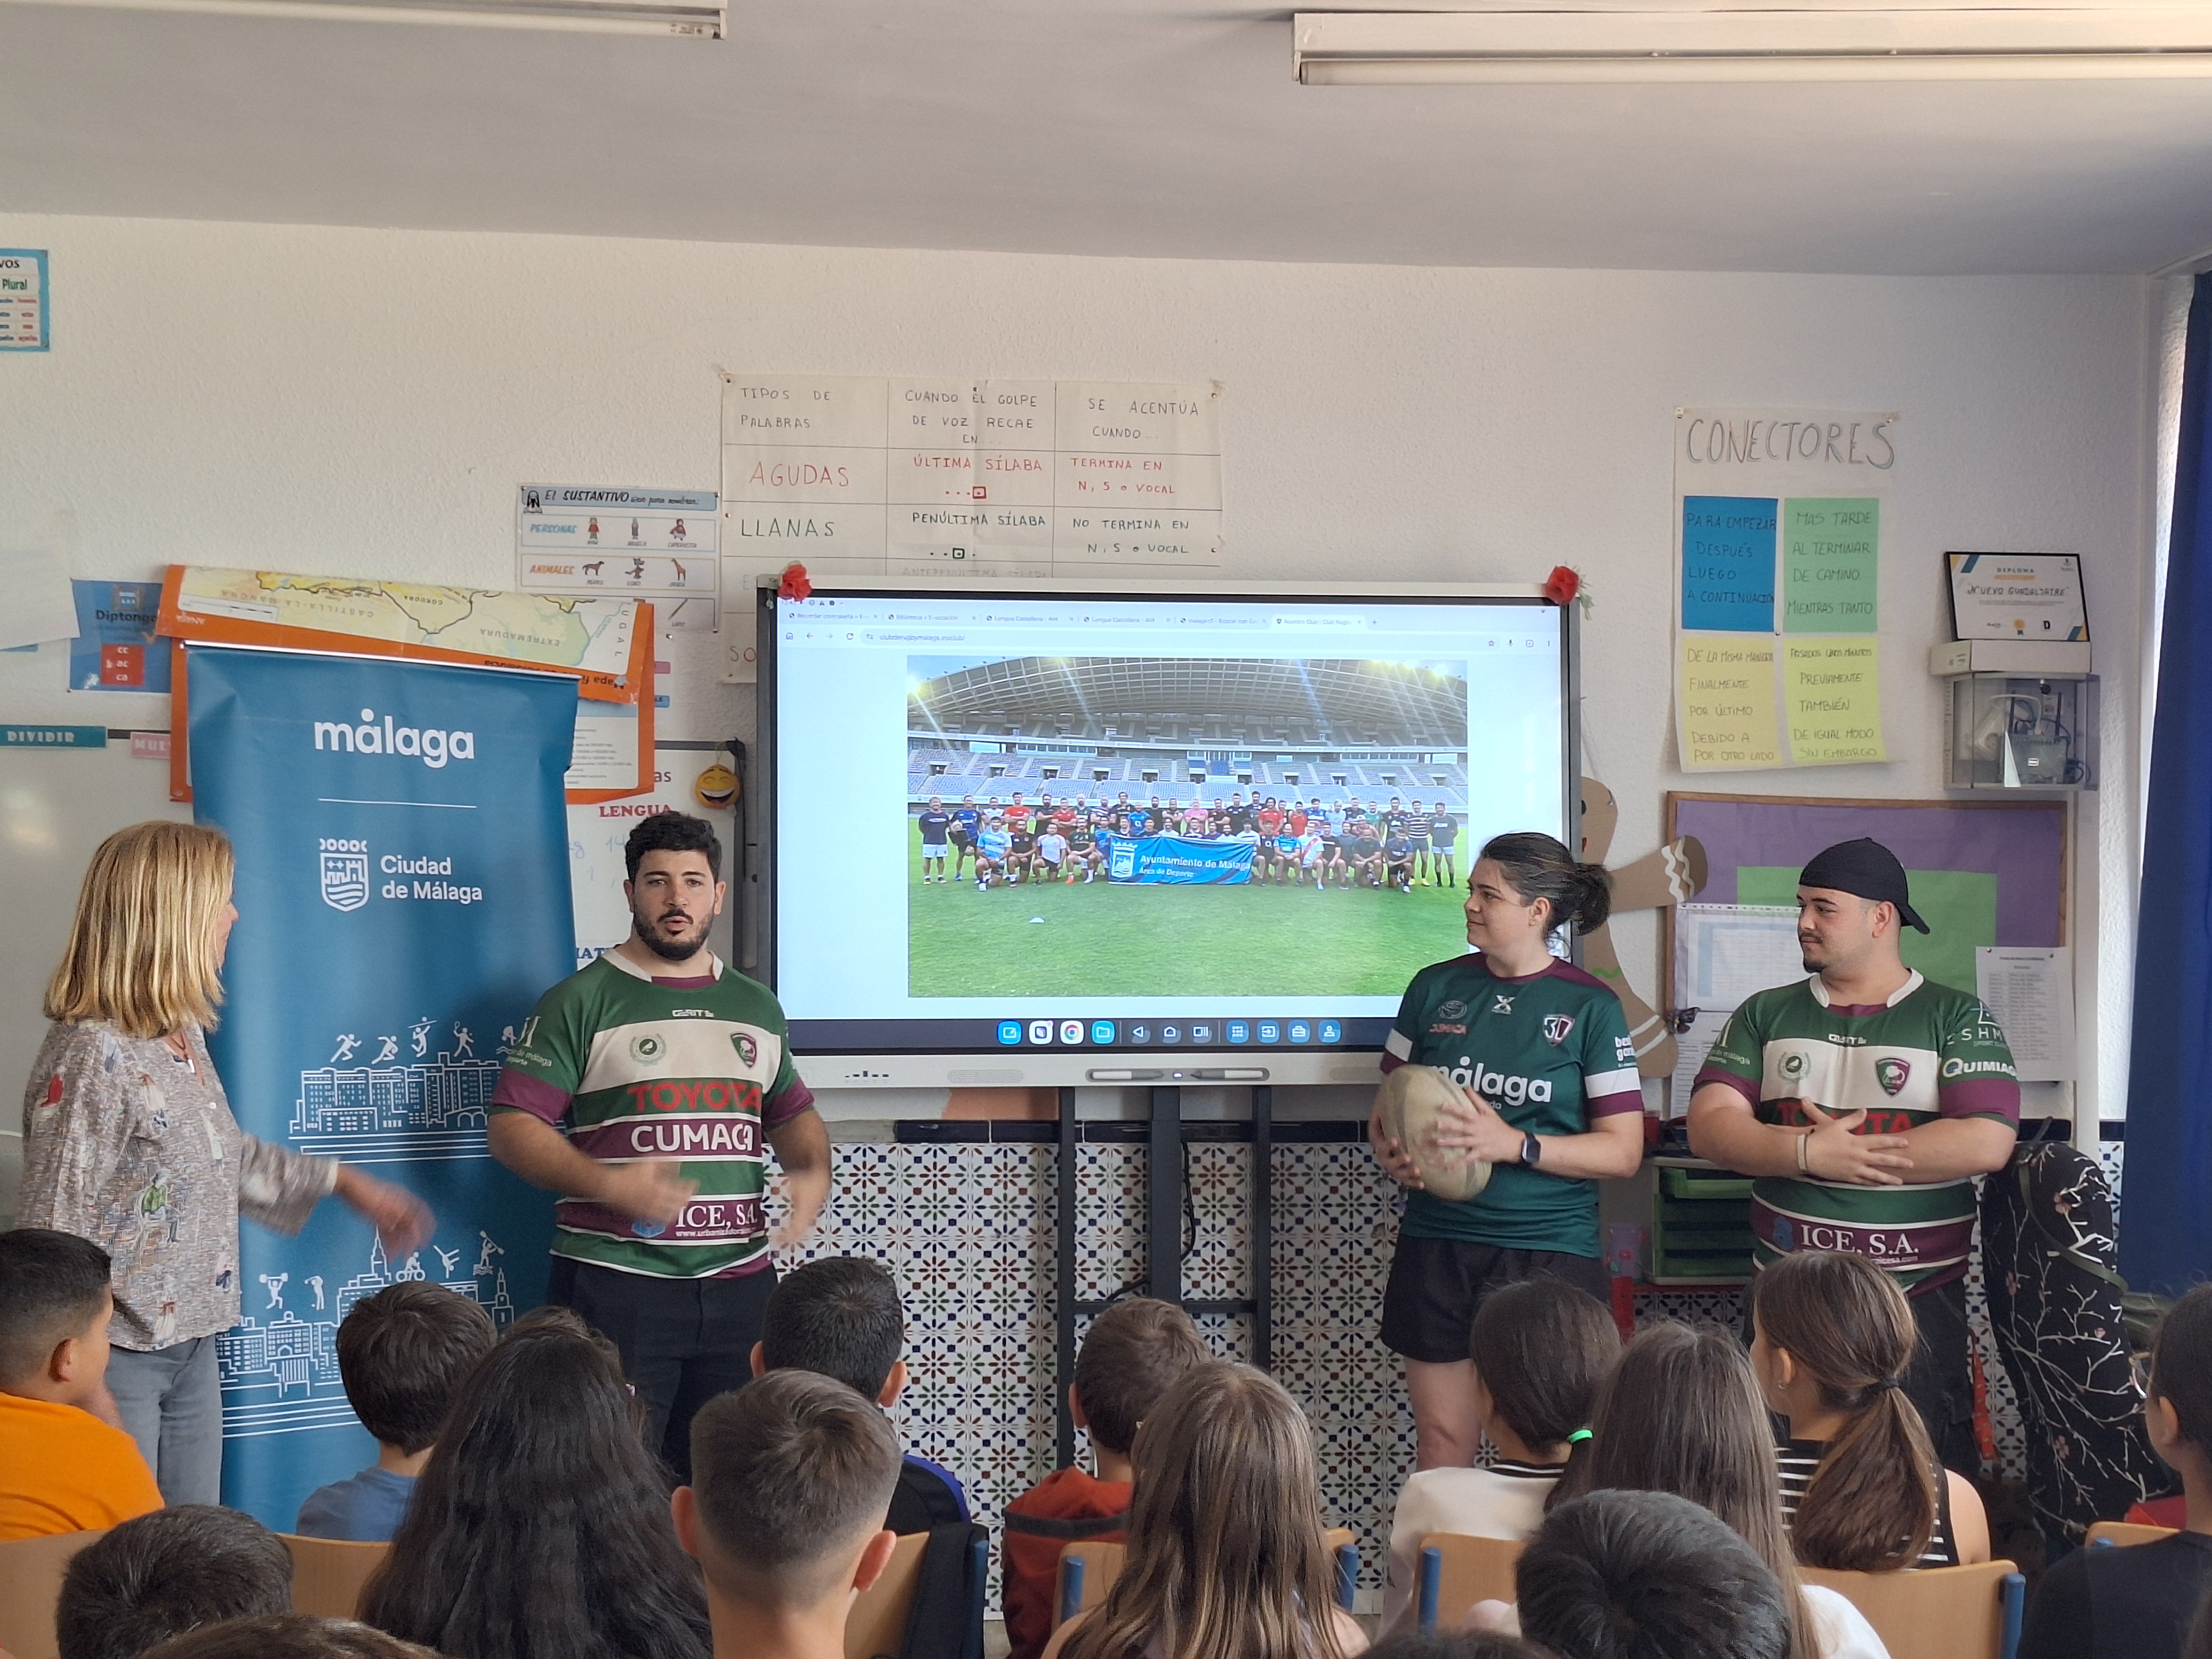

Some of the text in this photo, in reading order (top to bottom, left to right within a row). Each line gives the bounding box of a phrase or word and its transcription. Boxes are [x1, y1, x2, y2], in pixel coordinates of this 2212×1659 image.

[3, 279, 27, 290] Plural
[741, 388, 831, 401] TIPOS DE
[905, 390, 1038, 407] CUANDO EL GOLPE
[1088, 398, 1199, 416] SE ACENTÚA
[741, 414, 811, 429] PALABRAS
[912, 415, 1034, 428] DE VOZ RECAE
[1686, 418, 1895, 470] CONECTORES
[914, 453, 1043, 471] ÚLTIMA SÍLABA
[1070, 458, 1162, 471] TERMINA EN
[749, 461, 850, 487] AGUDAS
[1103, 481, 1110, 491] S
[1136, 484, 1176, 494] VOCAL
[562, 490, 630, 503] SUSTANTIVO
[912, 510, 1046, 526] PENÚLTIMA SÍLABA
[1073, 518, 1189, 530] NO TERMINA EN
[1687, 512, 1777, 531] PARA EMPEZAR
[1832, 511, 1872, 526] TARDE
[529, 523, 578, 535] PERSONAS
[741, 517, 834, 537] LLANAS
[1113, 543, 1121, 552] S
[1148, 544, 1189, 554] VOCAL
[1696, 541, 1753, 558] DESPUÉS
[1792, 541, 1871, 555] AL TERMINAR
[529, 564, 576, 575] ANIMALES
[1688, 567, 1736, 580] LUEGO
[1793, 568, 1860, 582] DE CAMINO
[1687, 590, 1696, 600] A
[1786, 600, 1873, 615] MIENTRAS TANTO
[479, 627, 561, 647] EXTREMADURA
[1687, 648, 1704, 663] DE
[1707, 651, 1718, 663] LA
[1689, 677, 1750, 691] FINALMENTE
[1799, 671, 1863, 686] PREVIAMENTE
[1689, 703, 1753, 717] POR ÚLTIMO
[1800, 698, 1850, 712] TAMBIÉN
[7, 730, 75, 743] DIVIDIR
[1692, 731, 1750, 744] DEBIDO A
[1793, 728, 1874, 740] DE IGUAL MODO
[134, 737, 171, 752] MUL
[1694, 749, 1774, 762] POR OTRO LADO
[1799, 747, 1877, 757] SIN EMBARGO
[599, 804, 672, 818] LENGUA
[381, 855, 452, 876] Ciudad
[1140, 854, 1203, 867] Ayuntamiento
[1205, 860, 1217, 868] de
[381, 881, 484, 905] de Málaga
[627, 1081, 762, 1112] TOYOTA
[1868, 1233, 1920, 1256] S.A.
